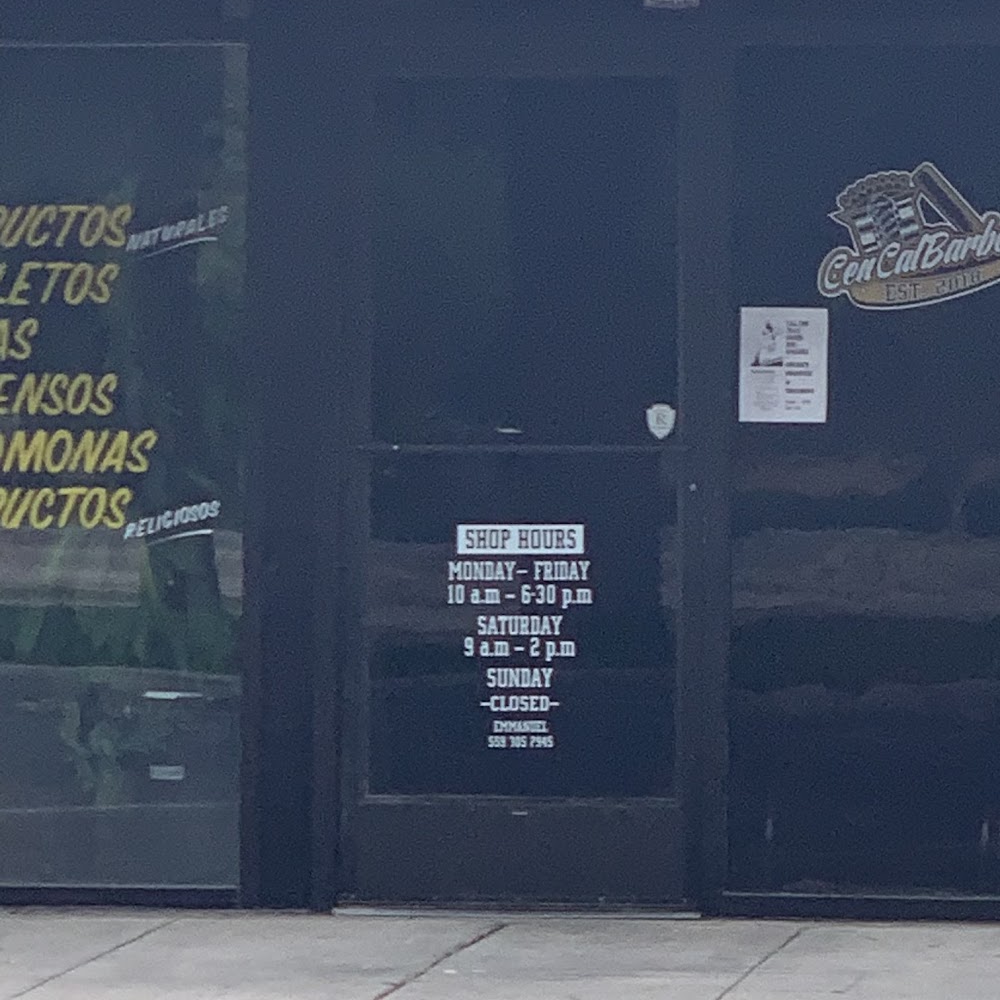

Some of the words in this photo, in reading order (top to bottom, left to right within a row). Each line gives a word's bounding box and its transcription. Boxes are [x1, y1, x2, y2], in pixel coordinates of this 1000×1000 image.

[123, 500, 221, 540] RELIGIOSOS
[465, 528, 512, 550] SHOP
[517, 528, 577, 550] HOURS
[533, 561, 592, 581] FRIDAY
[447, 584, 465, 604] 10
[470, 588, 501, 604] a.m
[561, 588, 593, 609] p.m
[477, 615, 564, 636] SATURDAY
[463, 636, 475, 657] 9
[479, 640, 510, 657] a.m
[529, 636, 541, 657] 2
[545, 640, 577, 662] p.m
[486, 667, 554, 688] SUNDAY
